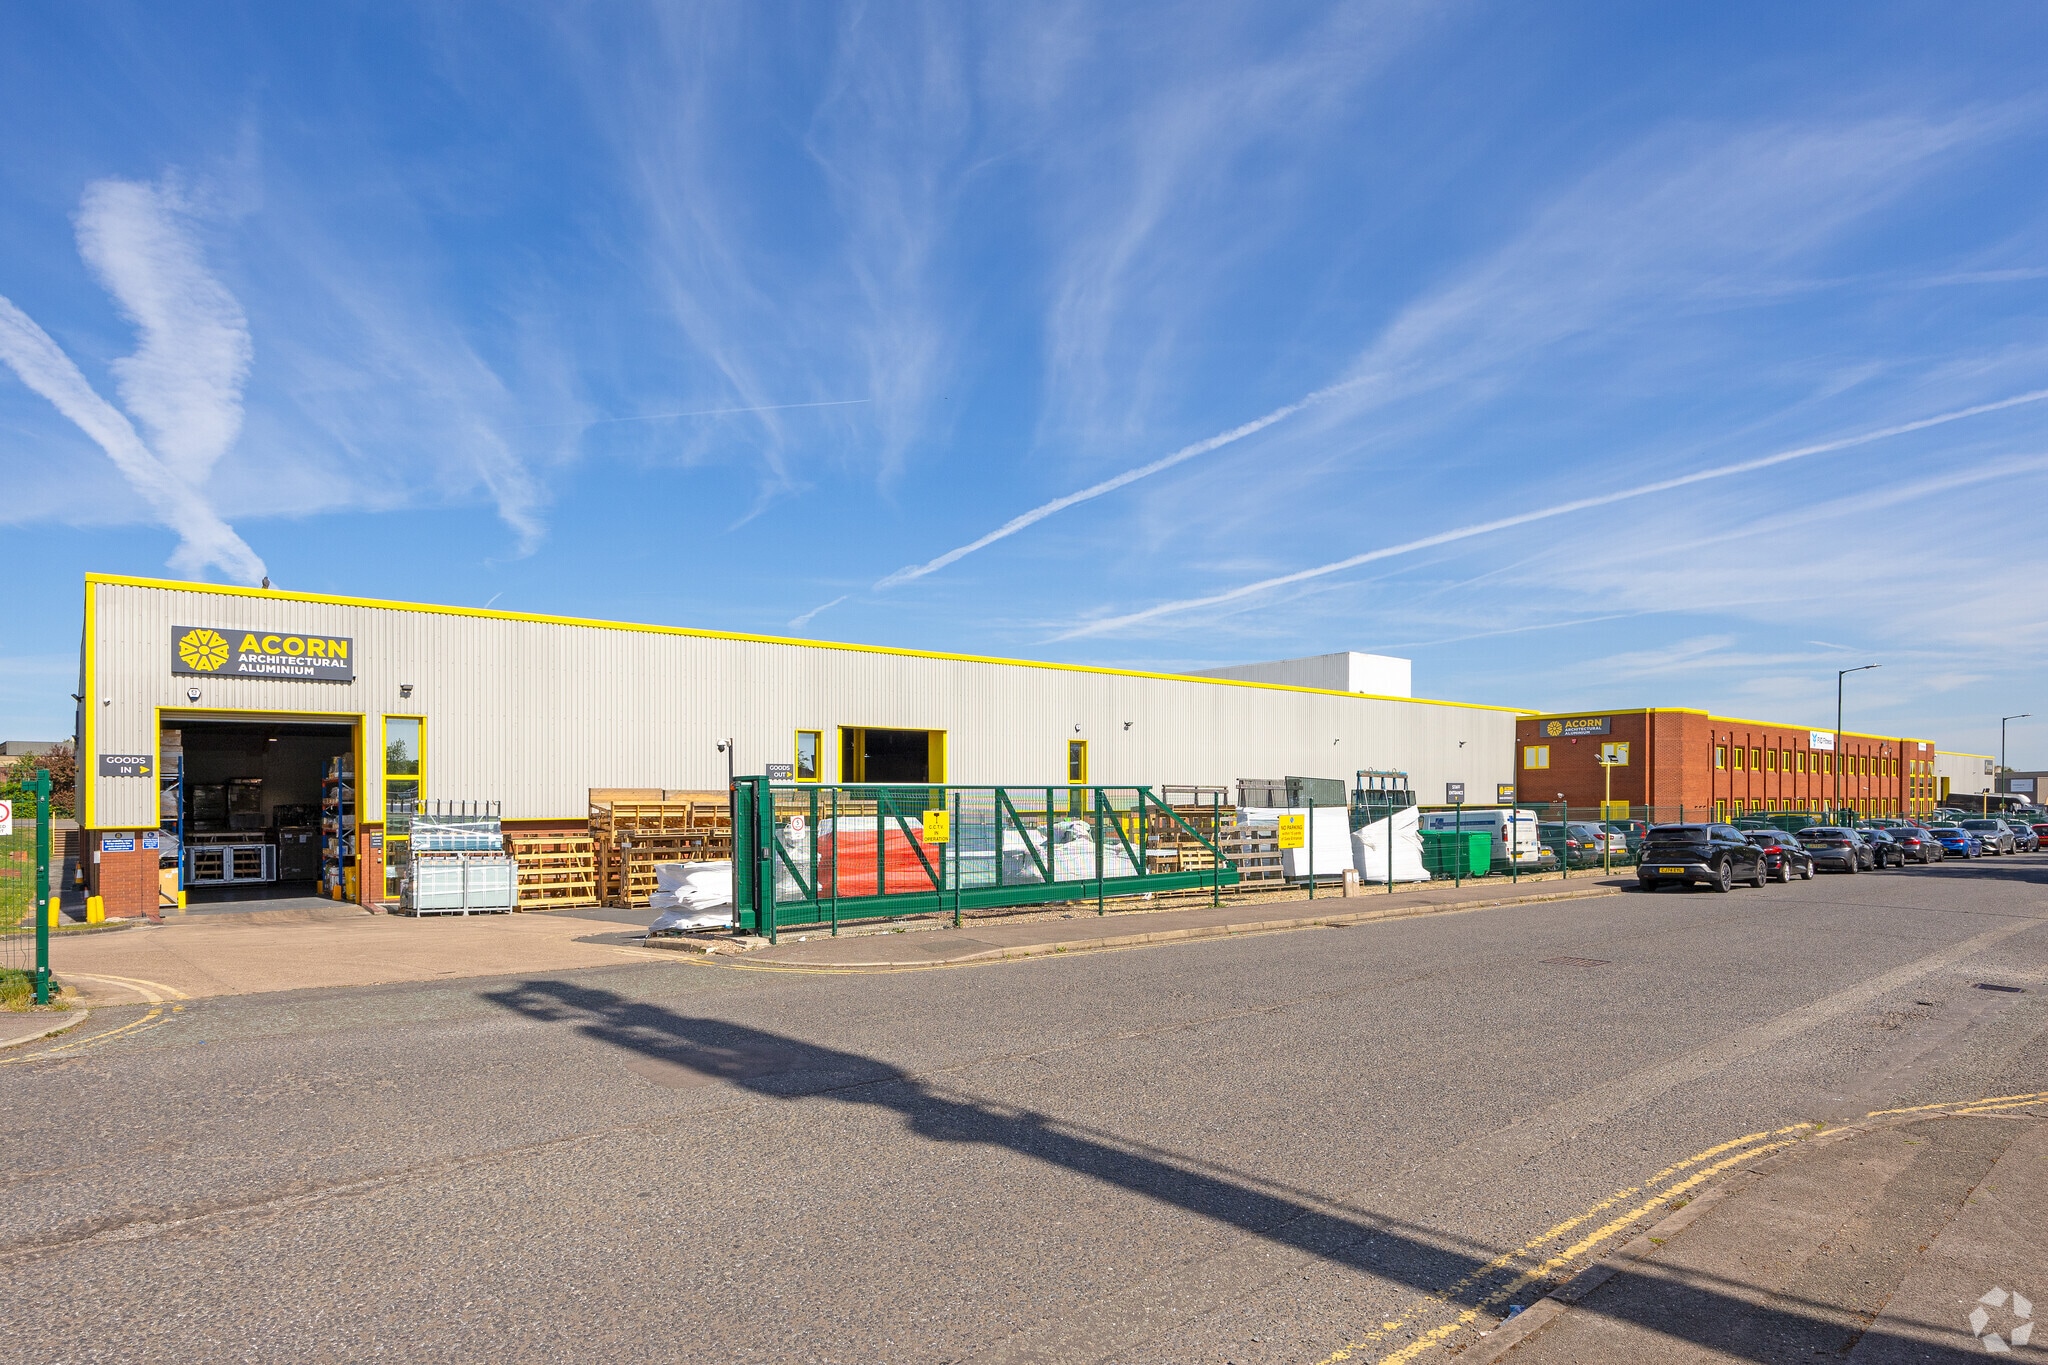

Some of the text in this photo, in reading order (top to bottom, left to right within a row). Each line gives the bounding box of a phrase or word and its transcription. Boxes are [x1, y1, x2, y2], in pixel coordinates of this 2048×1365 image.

[238, 634, 348, 658] ACORN
[238, 653, 348, 668] ARCHITECTURAL
[238, 663, 314, 676] ALUMINIUM
[1565, 719, 1602, 728] ACORN
[106, 756, 146, 764] GOODS
[120, 766, 132, 774] IN
